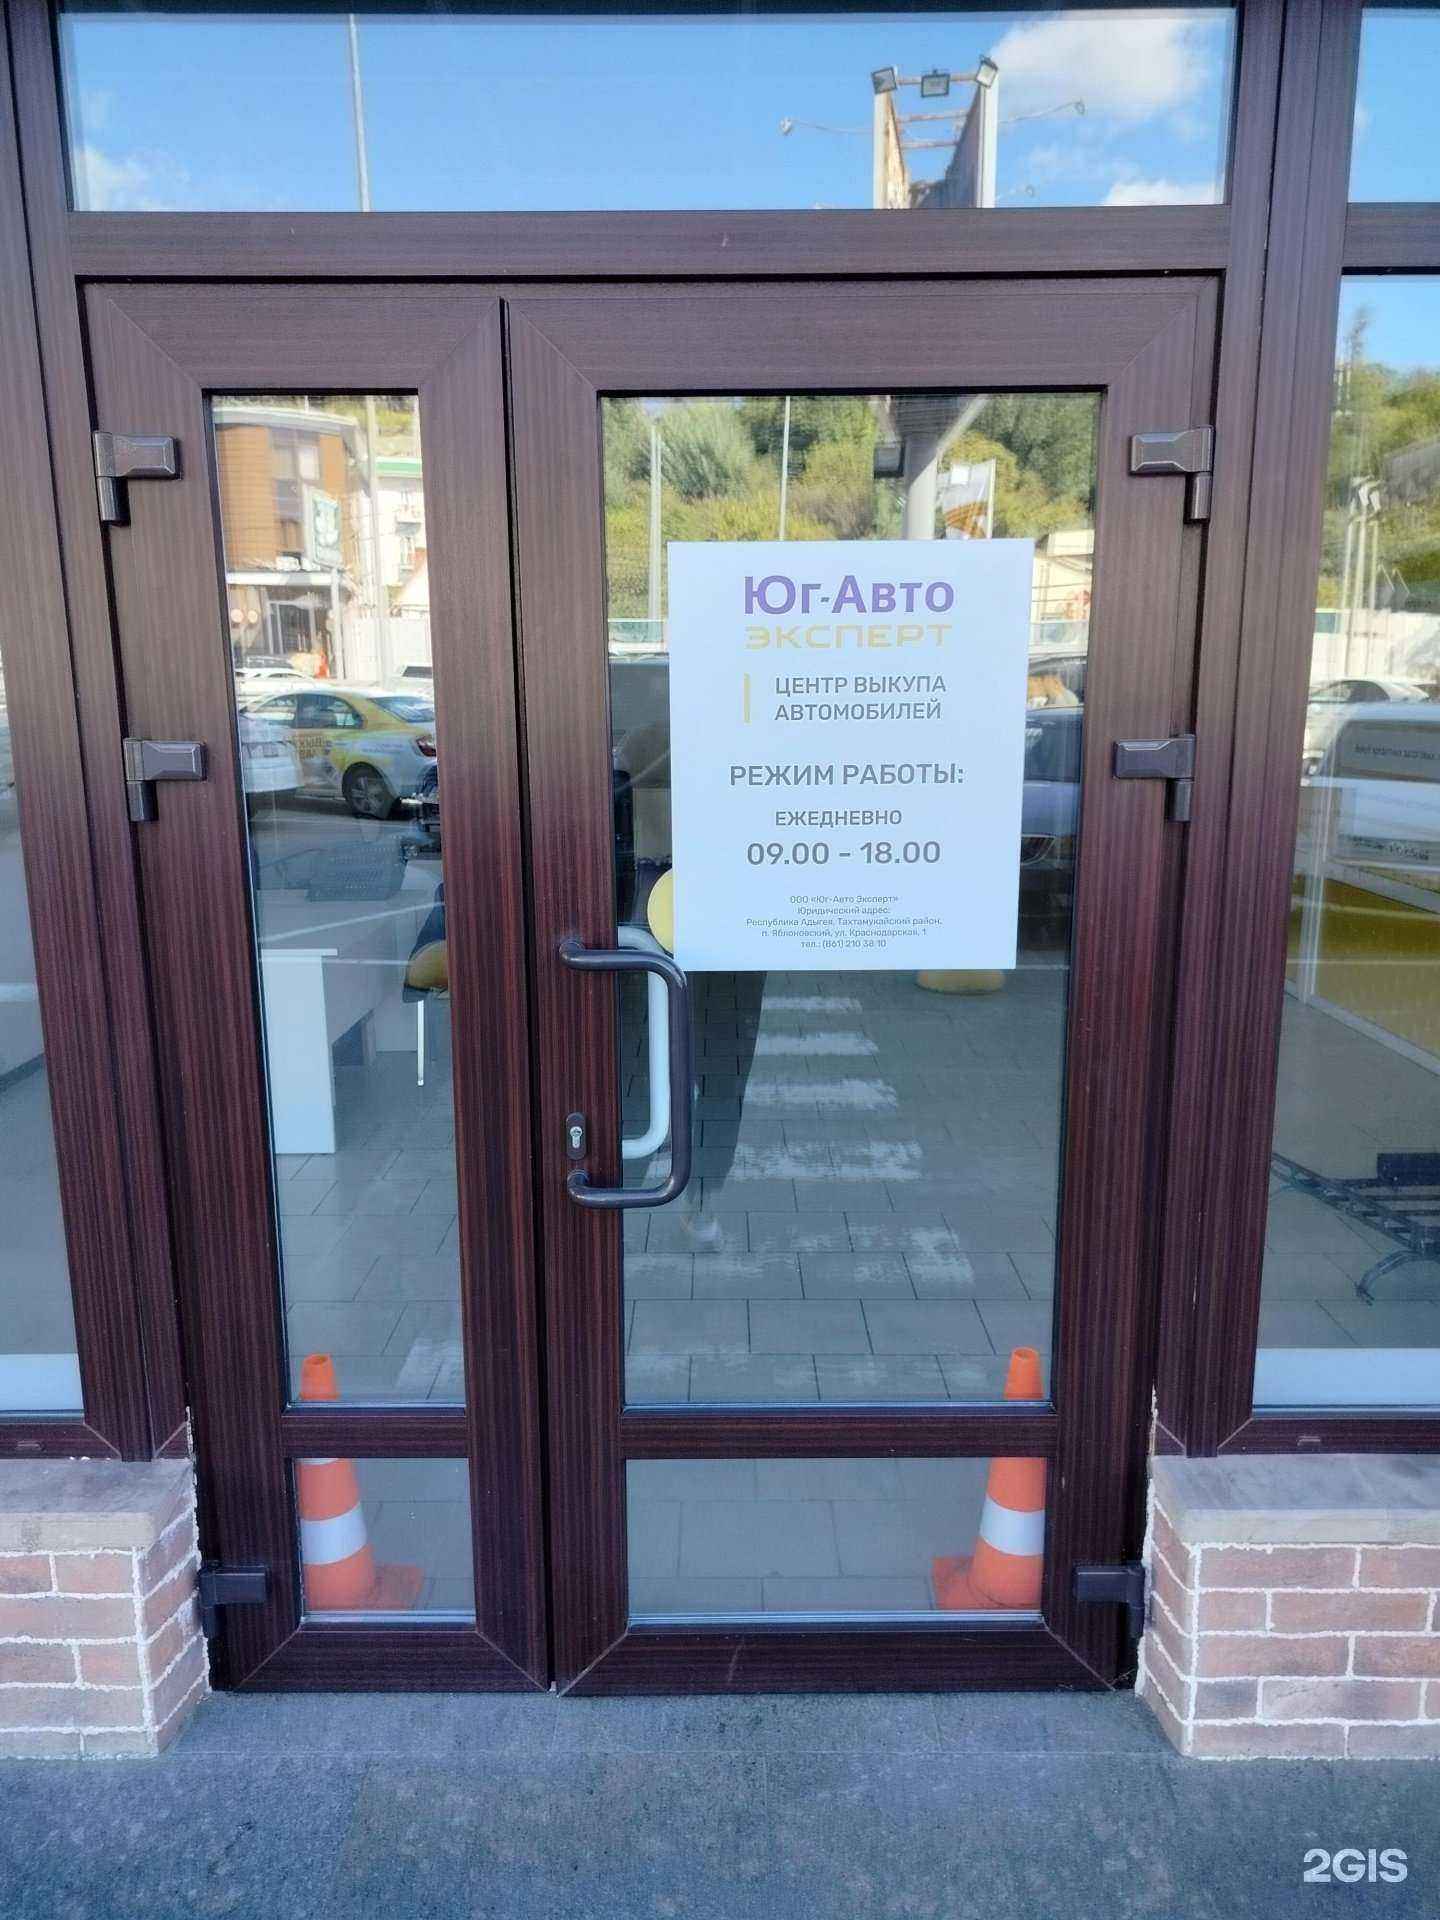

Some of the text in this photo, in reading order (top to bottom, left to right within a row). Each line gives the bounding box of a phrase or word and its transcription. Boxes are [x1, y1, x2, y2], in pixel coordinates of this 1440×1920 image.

[744, 575, 954, 615] Юг-Авто
[745, 624, 953, 649] ЭКСПЕРТ
[775, 675, 946, 697] ЦЕНТР ВЫКУПА
[774, 698, 941, 721] АВТОМОБИЛЕЙ
[730, 763, 964, 786] РЕЖИМ РАБОТЫ:
[775, 810, 902, 828] ЕЖЕДНЕВНО
[747, 842, 829, 865] 09.00
[860, 841, 941, 864] 18.00
[798, 906, 860, 915] Юридический
[746, 918, 799, 928] Республика
